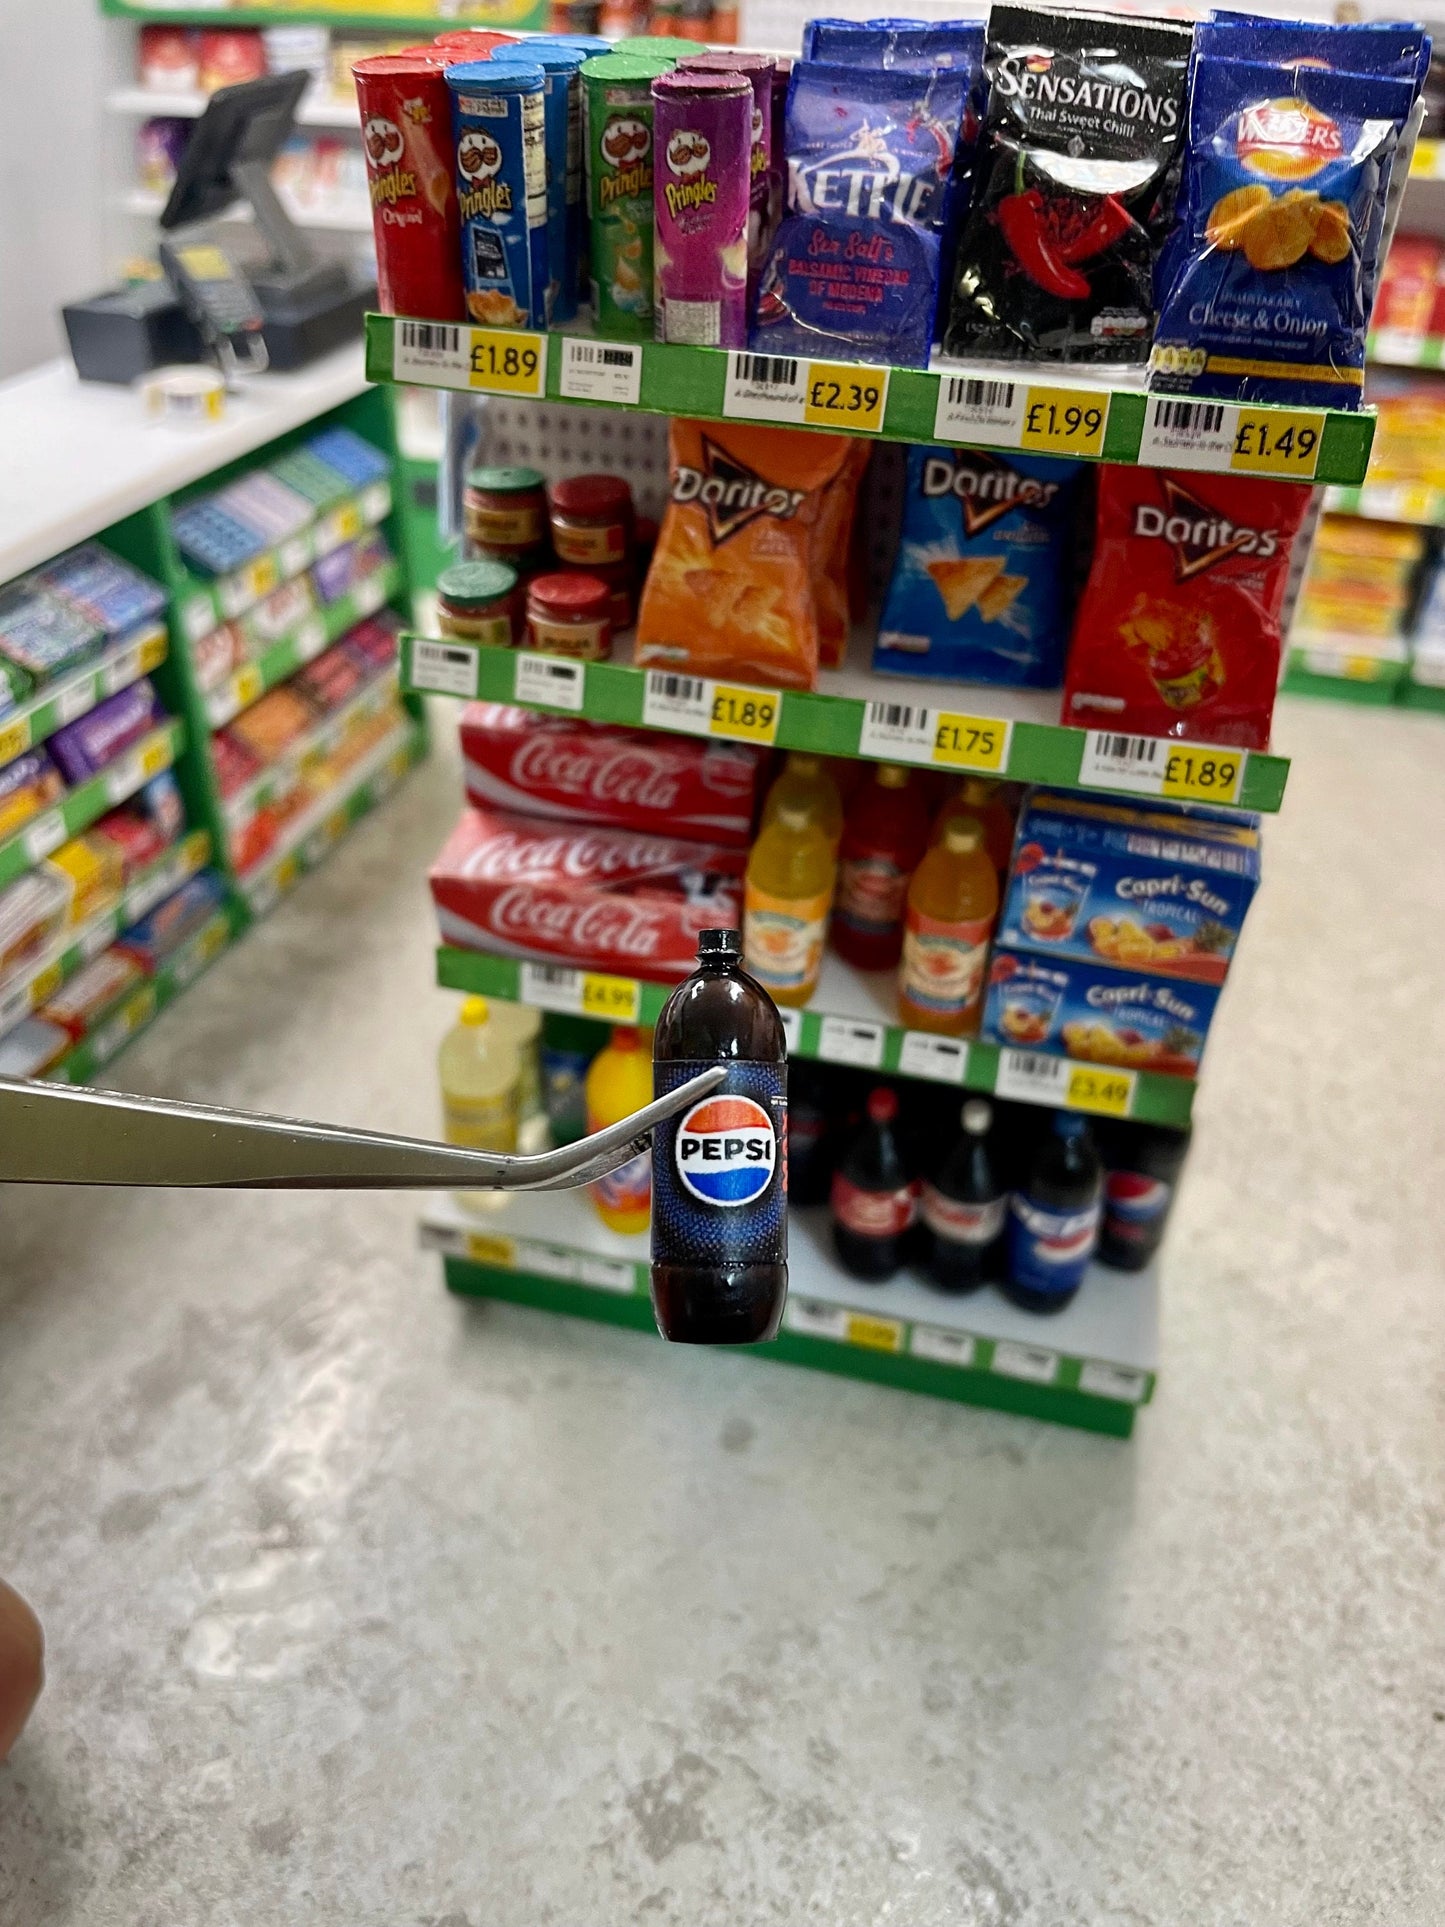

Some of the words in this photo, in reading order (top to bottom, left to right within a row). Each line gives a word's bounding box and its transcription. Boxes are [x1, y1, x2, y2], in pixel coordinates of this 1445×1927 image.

[995, 57, 1179, 128] SENSATIONS
[1030, 105, 1056, 122] Thai
[1058, 110, 1101, 130] Sweet
[1102, 118, 1136, 139] Chilli
[600, 162, 652, 207] Pringle
[665, 173, 717, 218] Pringles
[1188, 301, 1252, 329] Cheese
[1253, 307, 1270, 332] &
[1273, 310, 1329, 338] Onion
[469, 344, 538, 378] £1.89
[810, 381, 880, 413] £2.39
[1026, 403, 1102, 438] £1.99
[1234, 422, 1319, 460] £1.49
[923, 457, 1060, 509] Doritos
[1134, 504, 1279, 557] Doritos
[711, 696, 775, 729] £1.89
[935, 725, 995, 755] £1.75
[1164, 755, 1236, 789] £1.89
[681, 1138, 771, 1161] PEPSI
